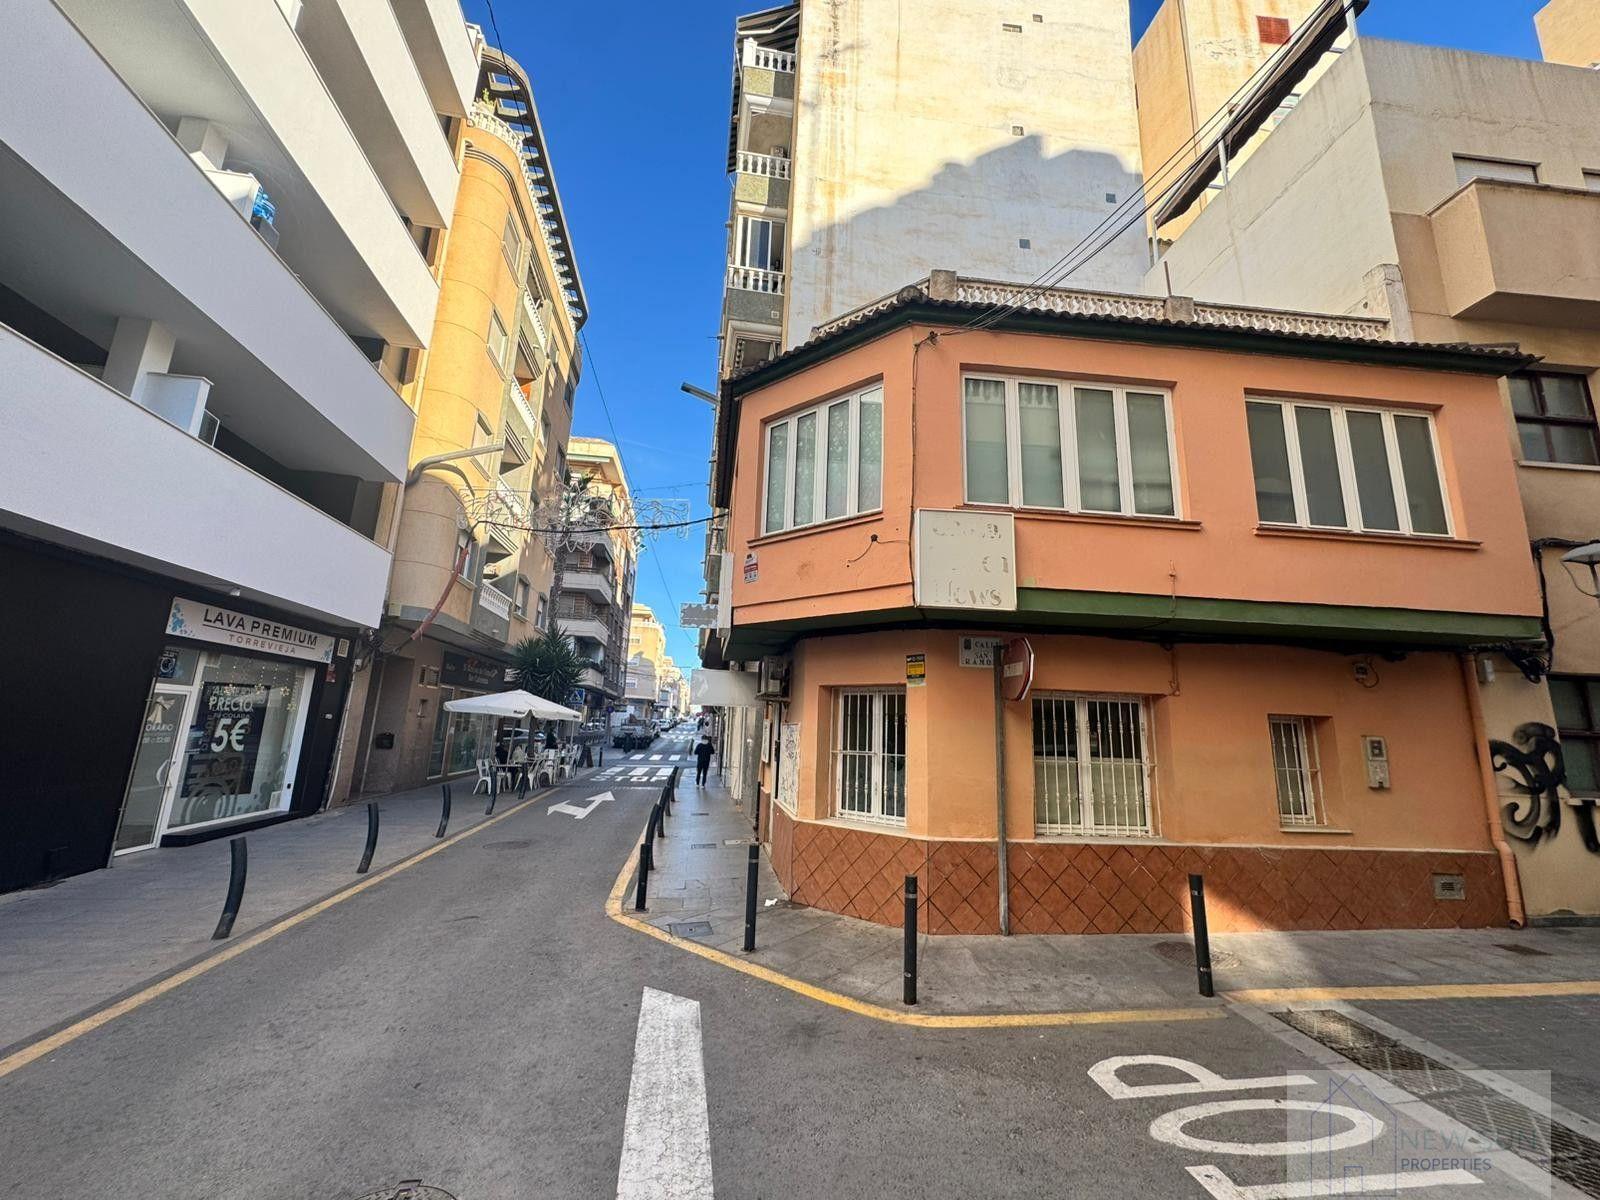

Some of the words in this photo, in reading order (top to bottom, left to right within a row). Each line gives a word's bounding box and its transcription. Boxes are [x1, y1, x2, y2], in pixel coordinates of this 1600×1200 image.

[203, 608, 246, 631] LAVA
[251, 620, 318, 646] PREMIUM
[229, 634, 296, 655] TORREVIEJA
[965, 657, 992, 666] RAMO
[209, 696, 252, 712] PRECIO
[210, 718, 249, 753] 5€
